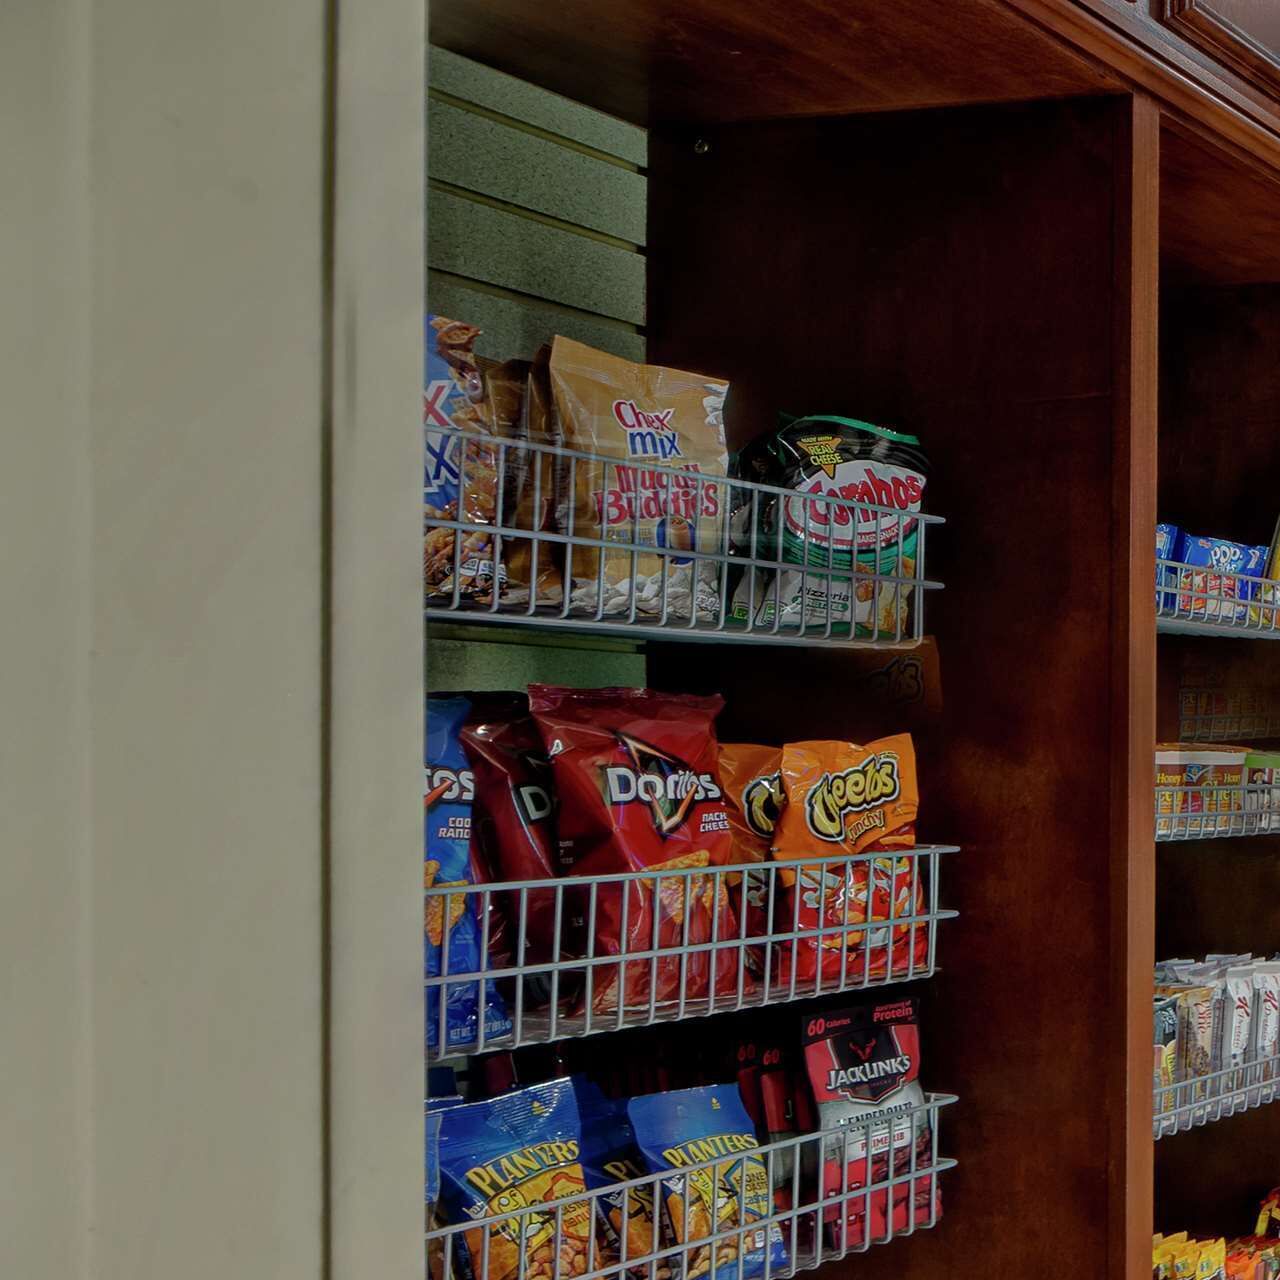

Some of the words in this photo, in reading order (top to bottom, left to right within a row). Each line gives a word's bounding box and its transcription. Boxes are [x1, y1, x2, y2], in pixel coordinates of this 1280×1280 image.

[613, 401, 675, 432] Chex
[628, 430, 682, 459] mix
[809, 444, 834, 455] REAL
[810, 453, 844, 466] CHEESE
[802, 468, 922, 526] Combos
[607, 767, 721, 802] Doritos
[811, 758, 898, 837] Cheetos
[807, 1018, 826, 1037] 60
[873, 1005, 913, 1022] Protein
[763, 1048, 780, 1065] 60
[827, 1064, 868, 1089] JACK
[661, 1134, 759, 1169] PLANTERS
[465, 1140, 580, 1197] PLANTERS
